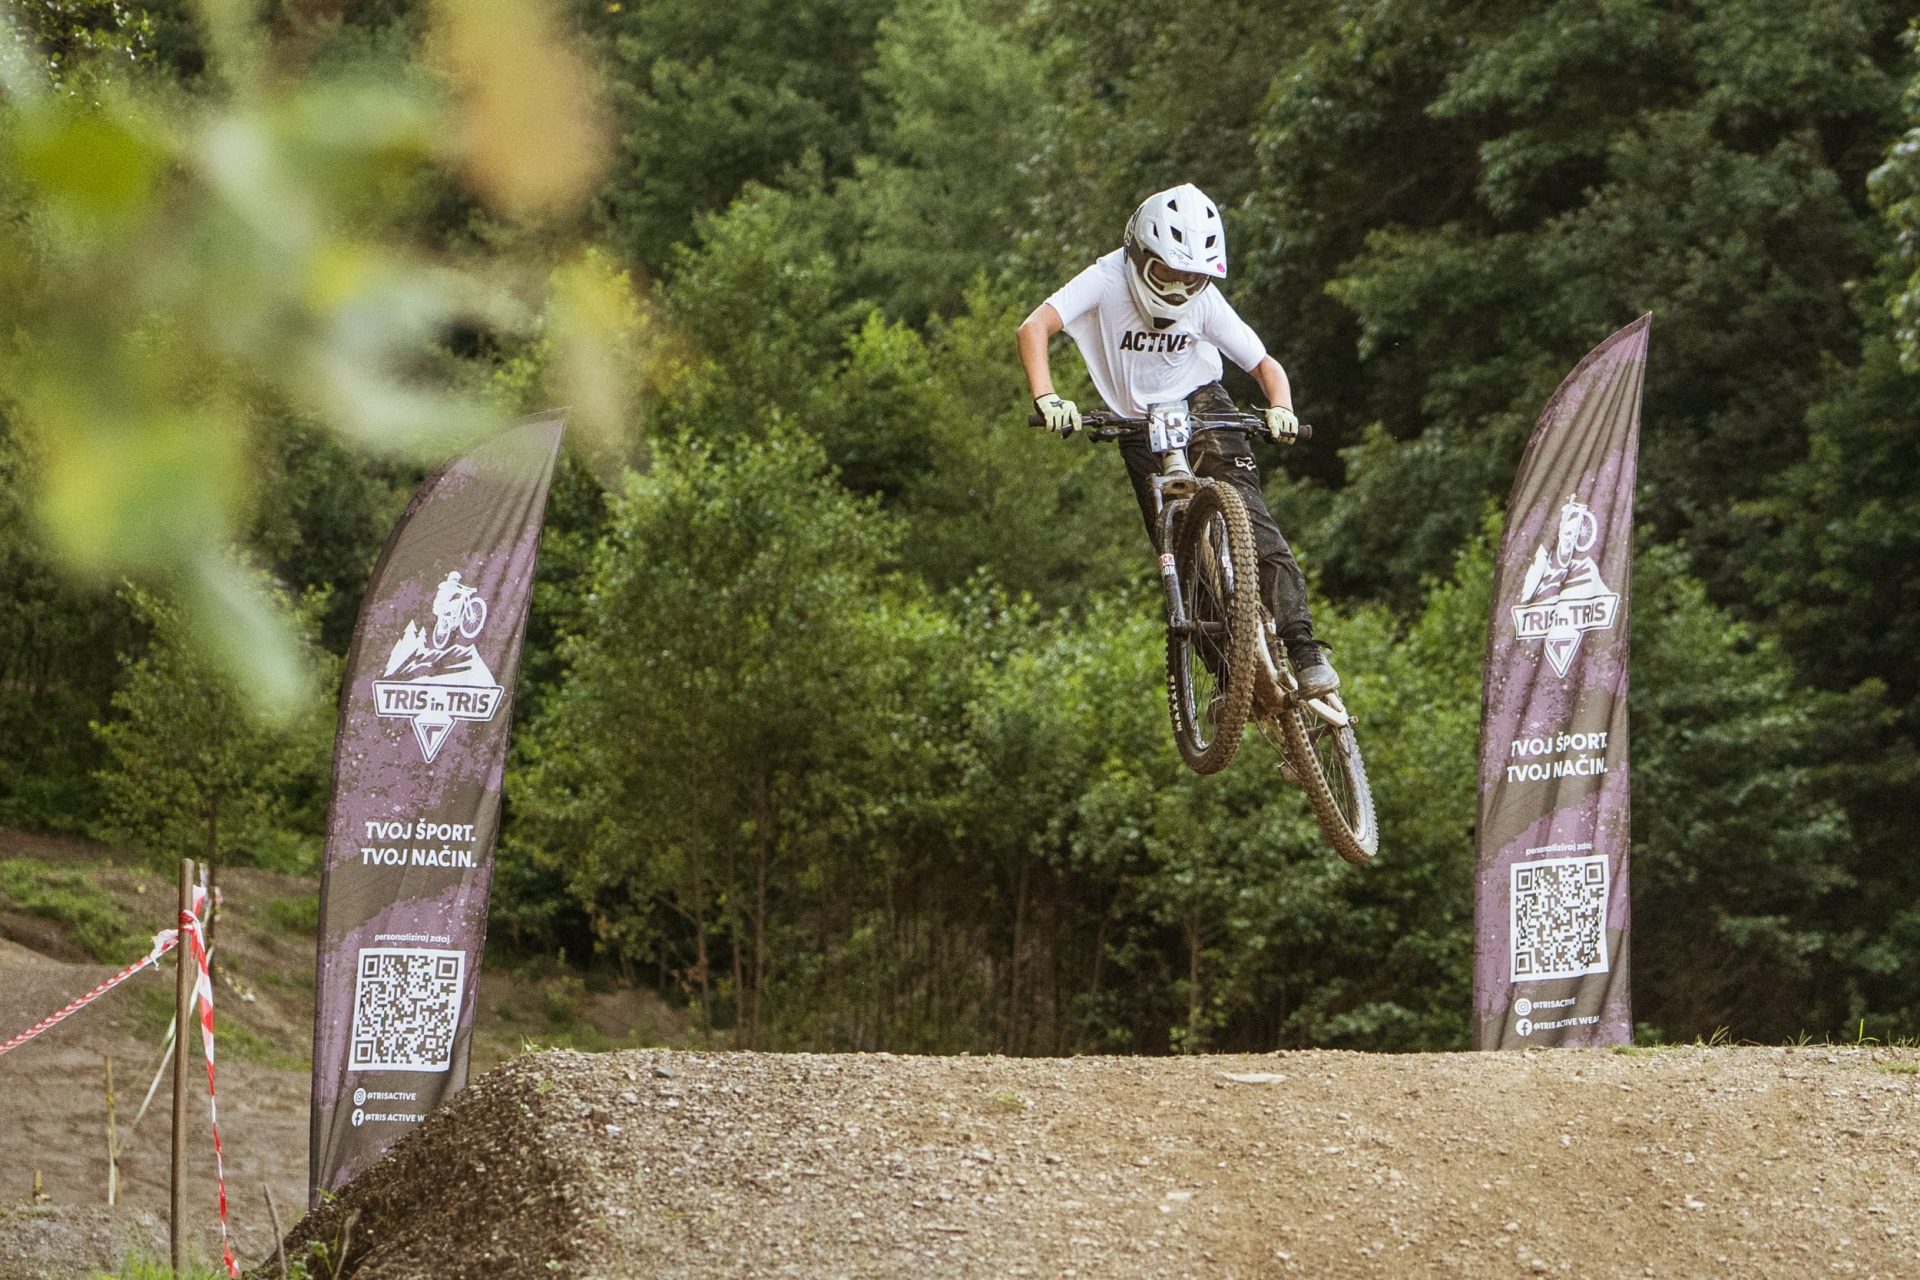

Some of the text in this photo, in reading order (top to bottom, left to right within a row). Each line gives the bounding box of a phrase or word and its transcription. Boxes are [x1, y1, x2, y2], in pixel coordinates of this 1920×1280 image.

[1120, 331, 1189, 352] ACTIVE
[1522, 602, 1606, 631] TRIS in TRIS
[383, 689, 490, 713] TRIS in TRIS
[1511, 731, 1608, 757] TVOJ ŠPORT.
[1507, 754, 1608, 783] TVOJ NAČIN.
[365, 818, 477, 841] TVOJ ŠPORT.
[361, 844, 477, 868] TVOJ NAČIN.
[374, 932, 451, 945] personaliziraj zdaj
[367, 1091, 416, 1100] @TRISACTIVE
[365, 1113, 386, 1122] @TRIS
[387, 1114, 416, 1122] ACTIVE
